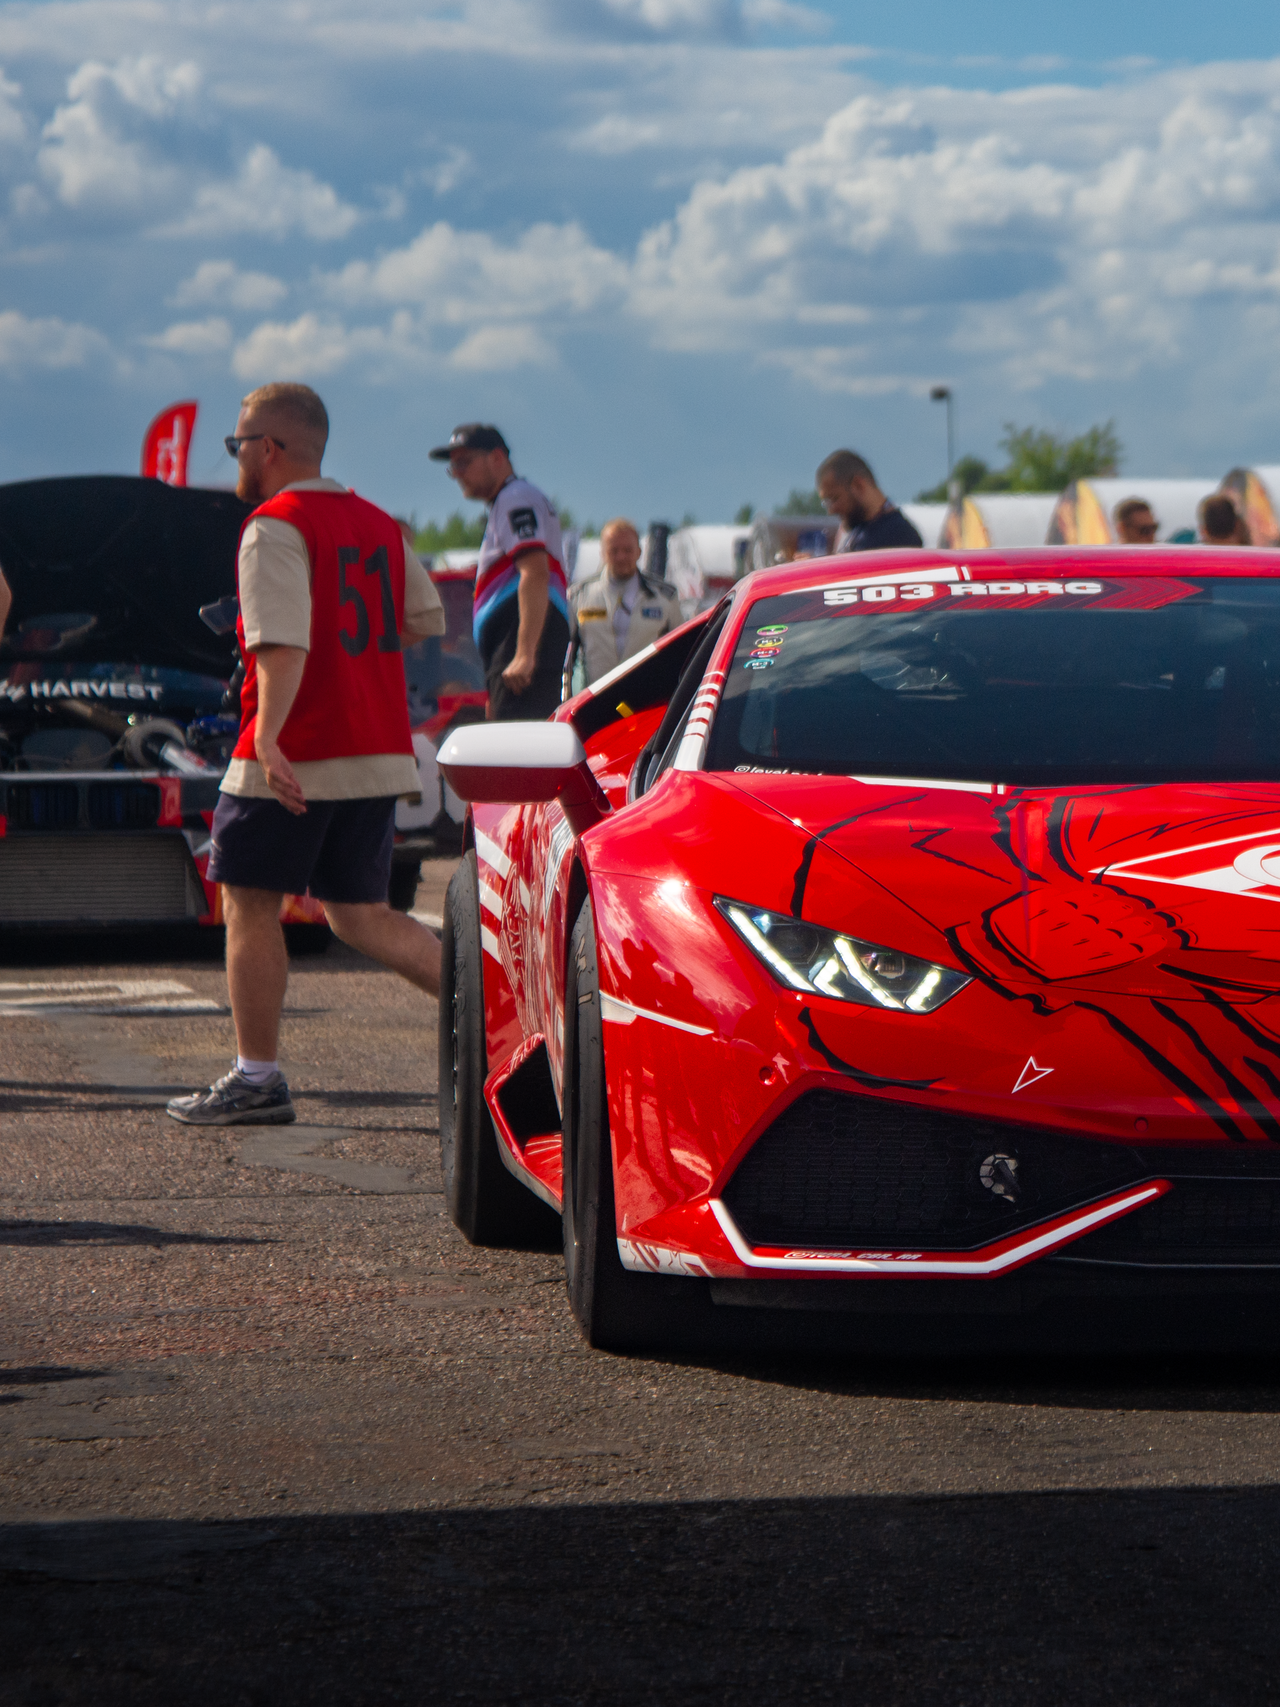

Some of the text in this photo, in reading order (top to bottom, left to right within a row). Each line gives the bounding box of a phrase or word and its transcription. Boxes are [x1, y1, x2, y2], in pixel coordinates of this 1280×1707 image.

[338, 545, 402, 657] 51
[823, 582, 1102, 606] 503 RDRC
[30, 681, 163, 700] HARVEST
